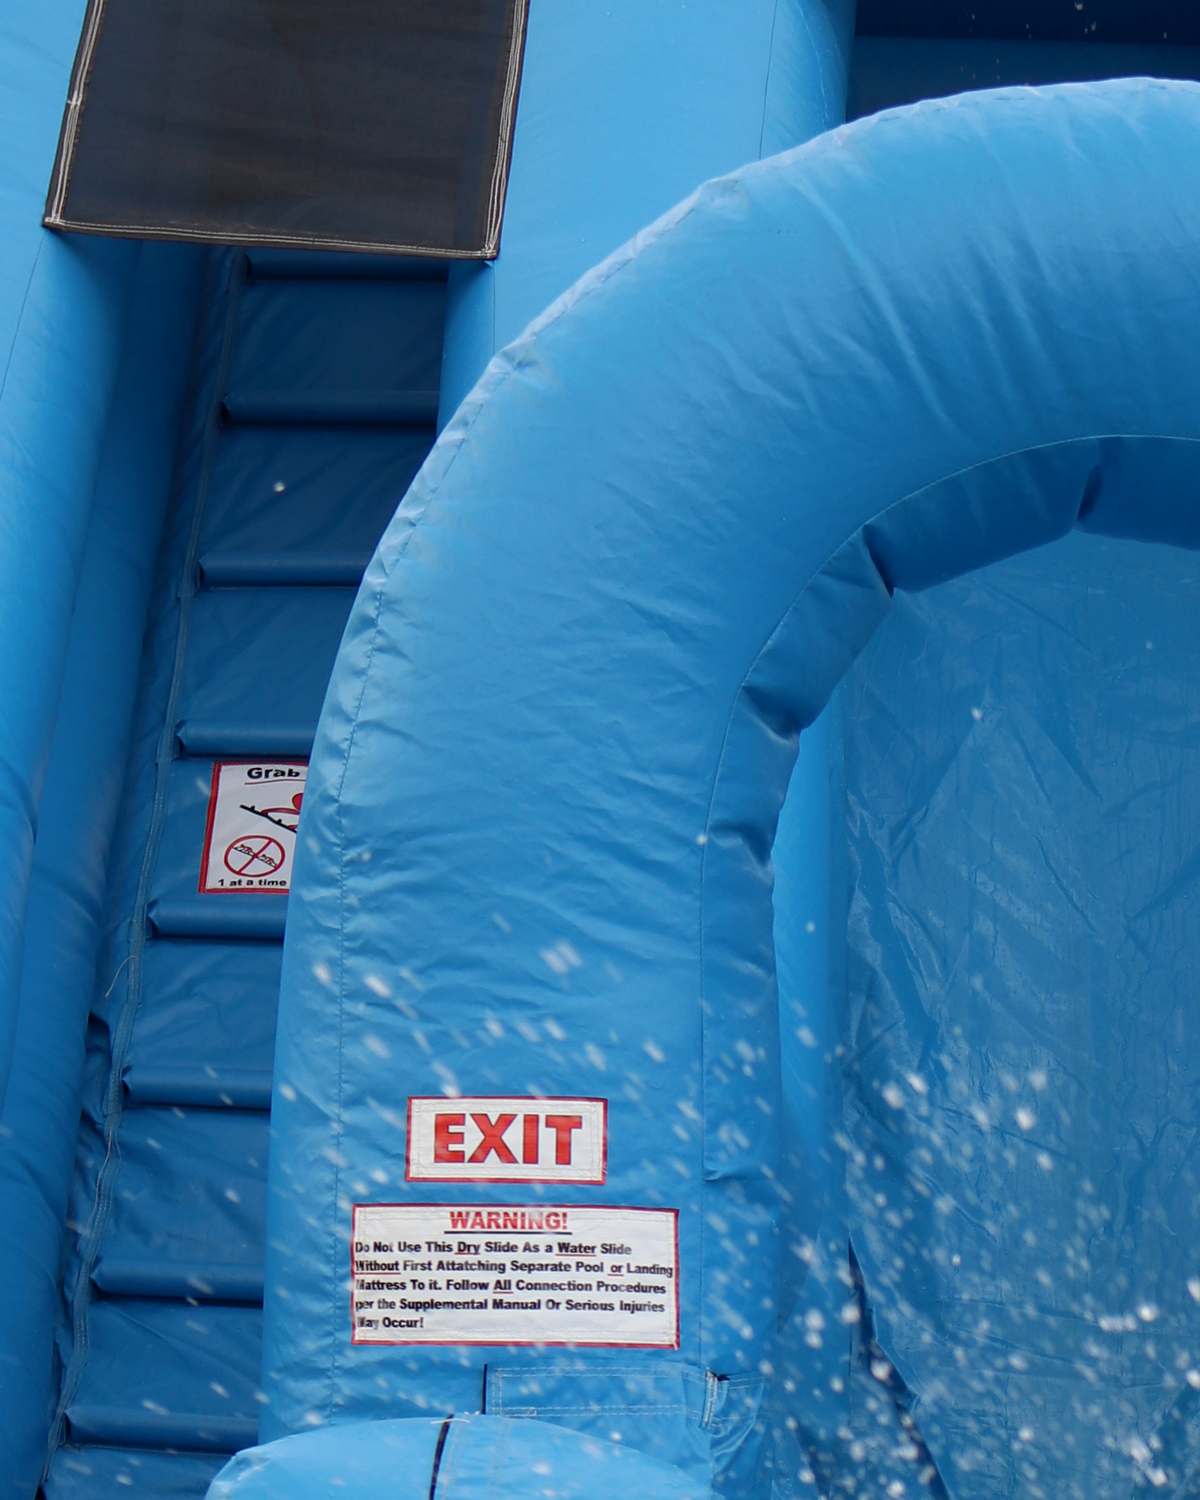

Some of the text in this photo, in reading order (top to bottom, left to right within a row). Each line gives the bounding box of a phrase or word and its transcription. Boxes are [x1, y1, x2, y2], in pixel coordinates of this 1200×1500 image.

[247, 767, 301, 780] Grab
[434, 1113, 583, 1165] EXIT
[450, 1211, 568, 1230] WARNING!
[355, 1241, 632, 1255] Do Not Use This Dry Slide As a Water Slide
[355, 1260, 673, 1278] Without First Attatching Separate Pool or Landing
[410, 1279, 425, 1290] To
[429, 1279, 442, 1290] it.
[446, 1279, 490, 1290] Follow
[493, 1280, 512, 1290] All
[516, 1280, 592, 1292] Connection
[597, 1281, 666, 1294] Procedures
[355, 1298, 665, 1314] per the Supplemental Manual Or Serious Injuries
[382, 1317, 424, 1328] Occur!
